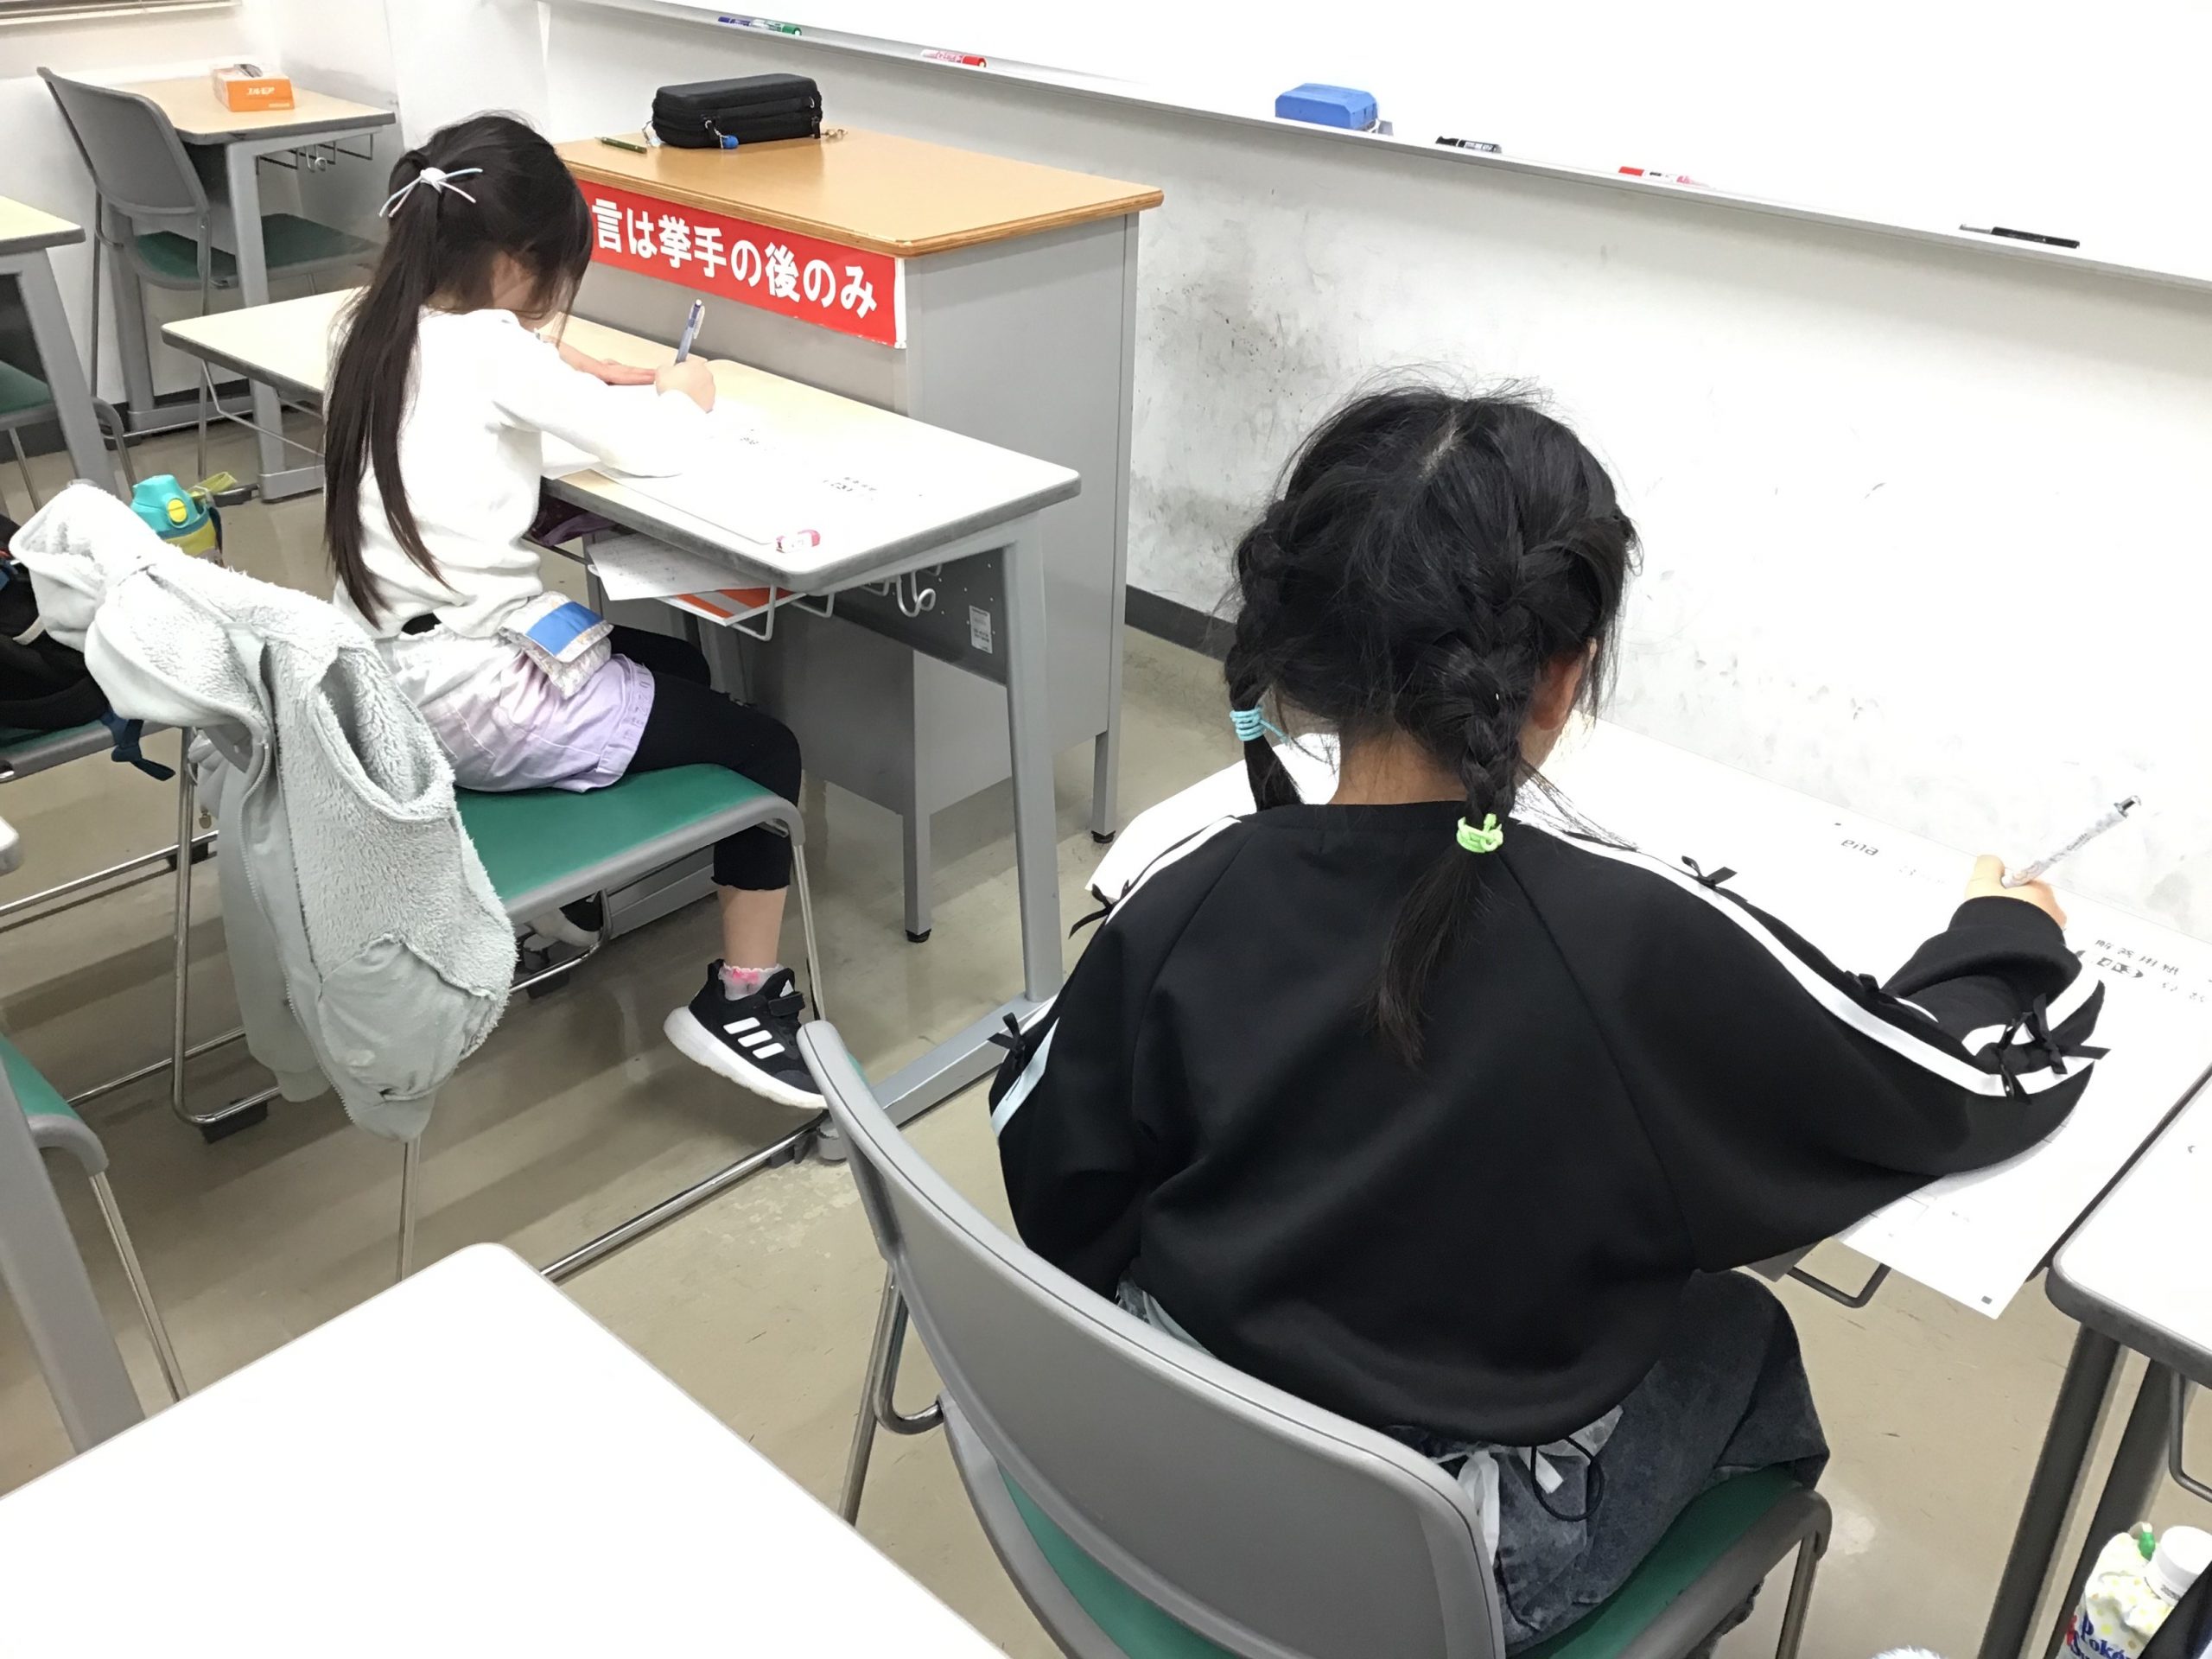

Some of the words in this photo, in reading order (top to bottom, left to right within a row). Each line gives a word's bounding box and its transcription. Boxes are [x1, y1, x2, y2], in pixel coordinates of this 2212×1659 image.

[592, 198, 877, 319] 言は挙手の後のみ
